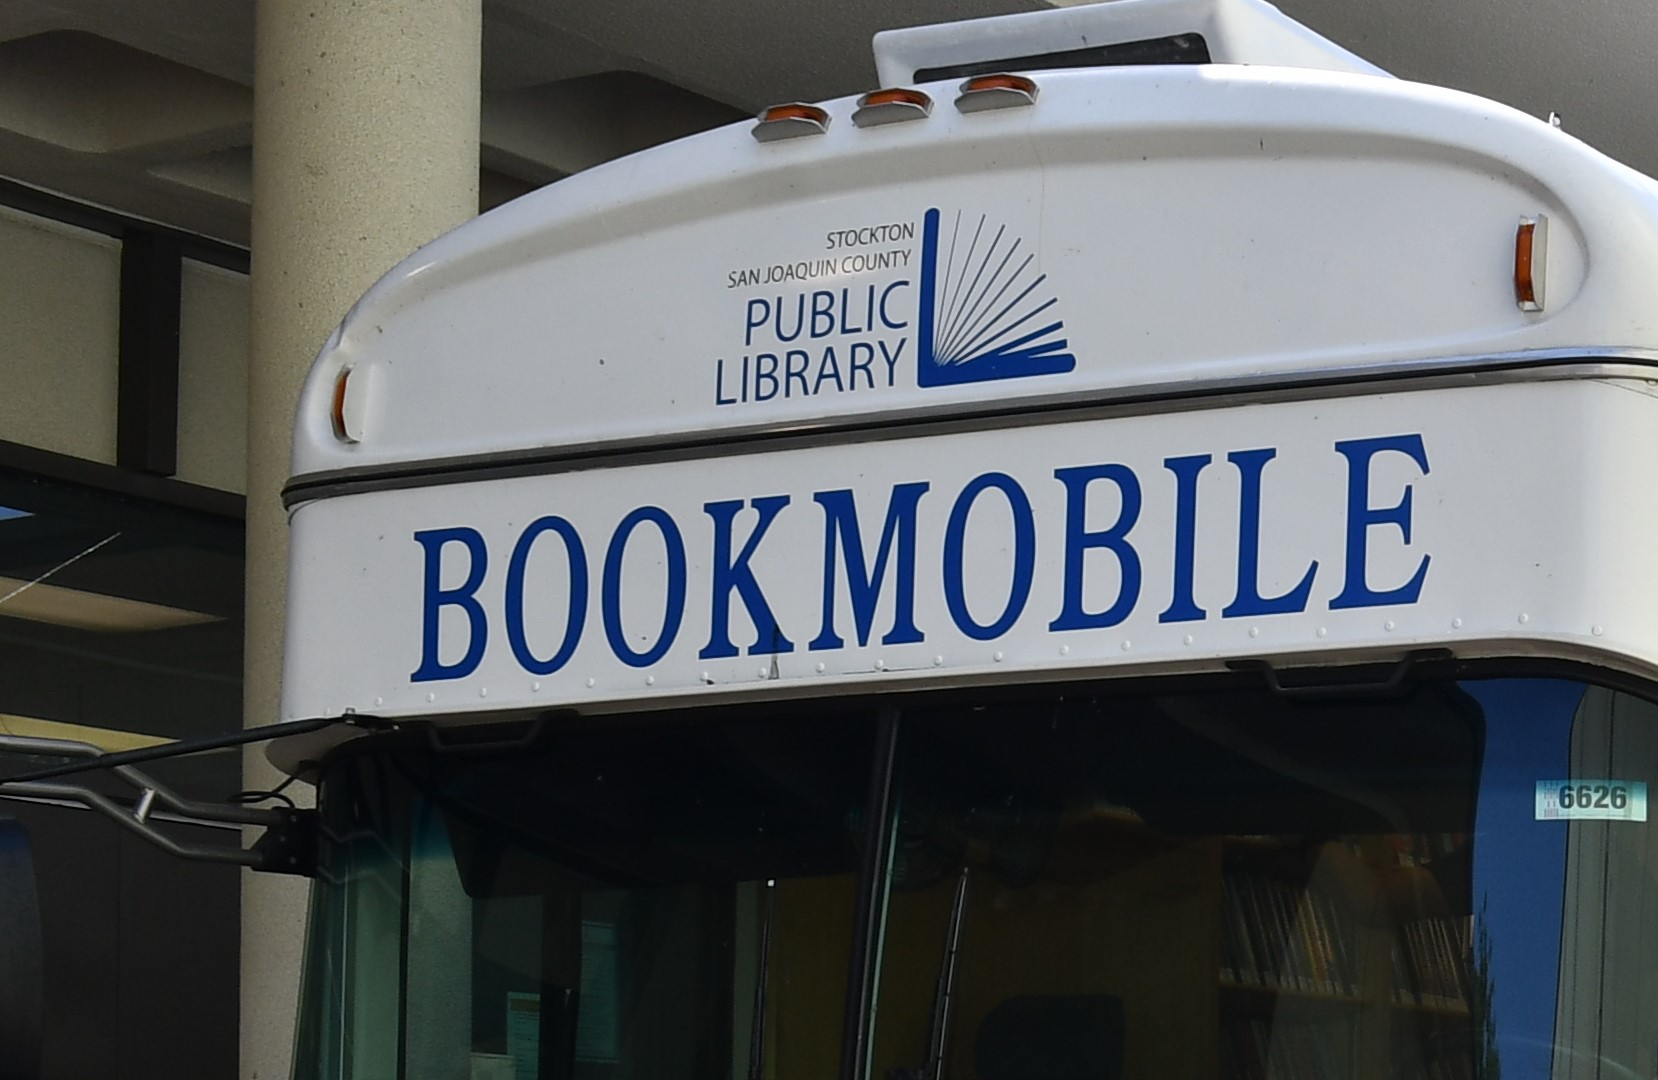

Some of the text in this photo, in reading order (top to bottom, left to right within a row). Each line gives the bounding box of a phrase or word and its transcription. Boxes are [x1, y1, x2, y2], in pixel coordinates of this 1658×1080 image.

[825, 222, 914, 249] STOCKTON
[727, 249, 912, 289] SAN JOAQUIN COUNTY
[745, 280, 910, 347] PUBLIC
[715, 338, 908, 406] LIBRARY
[410, 433, 1431, 683] BOOKMOBILE
[1558, 785, 1627, 809] 6626
